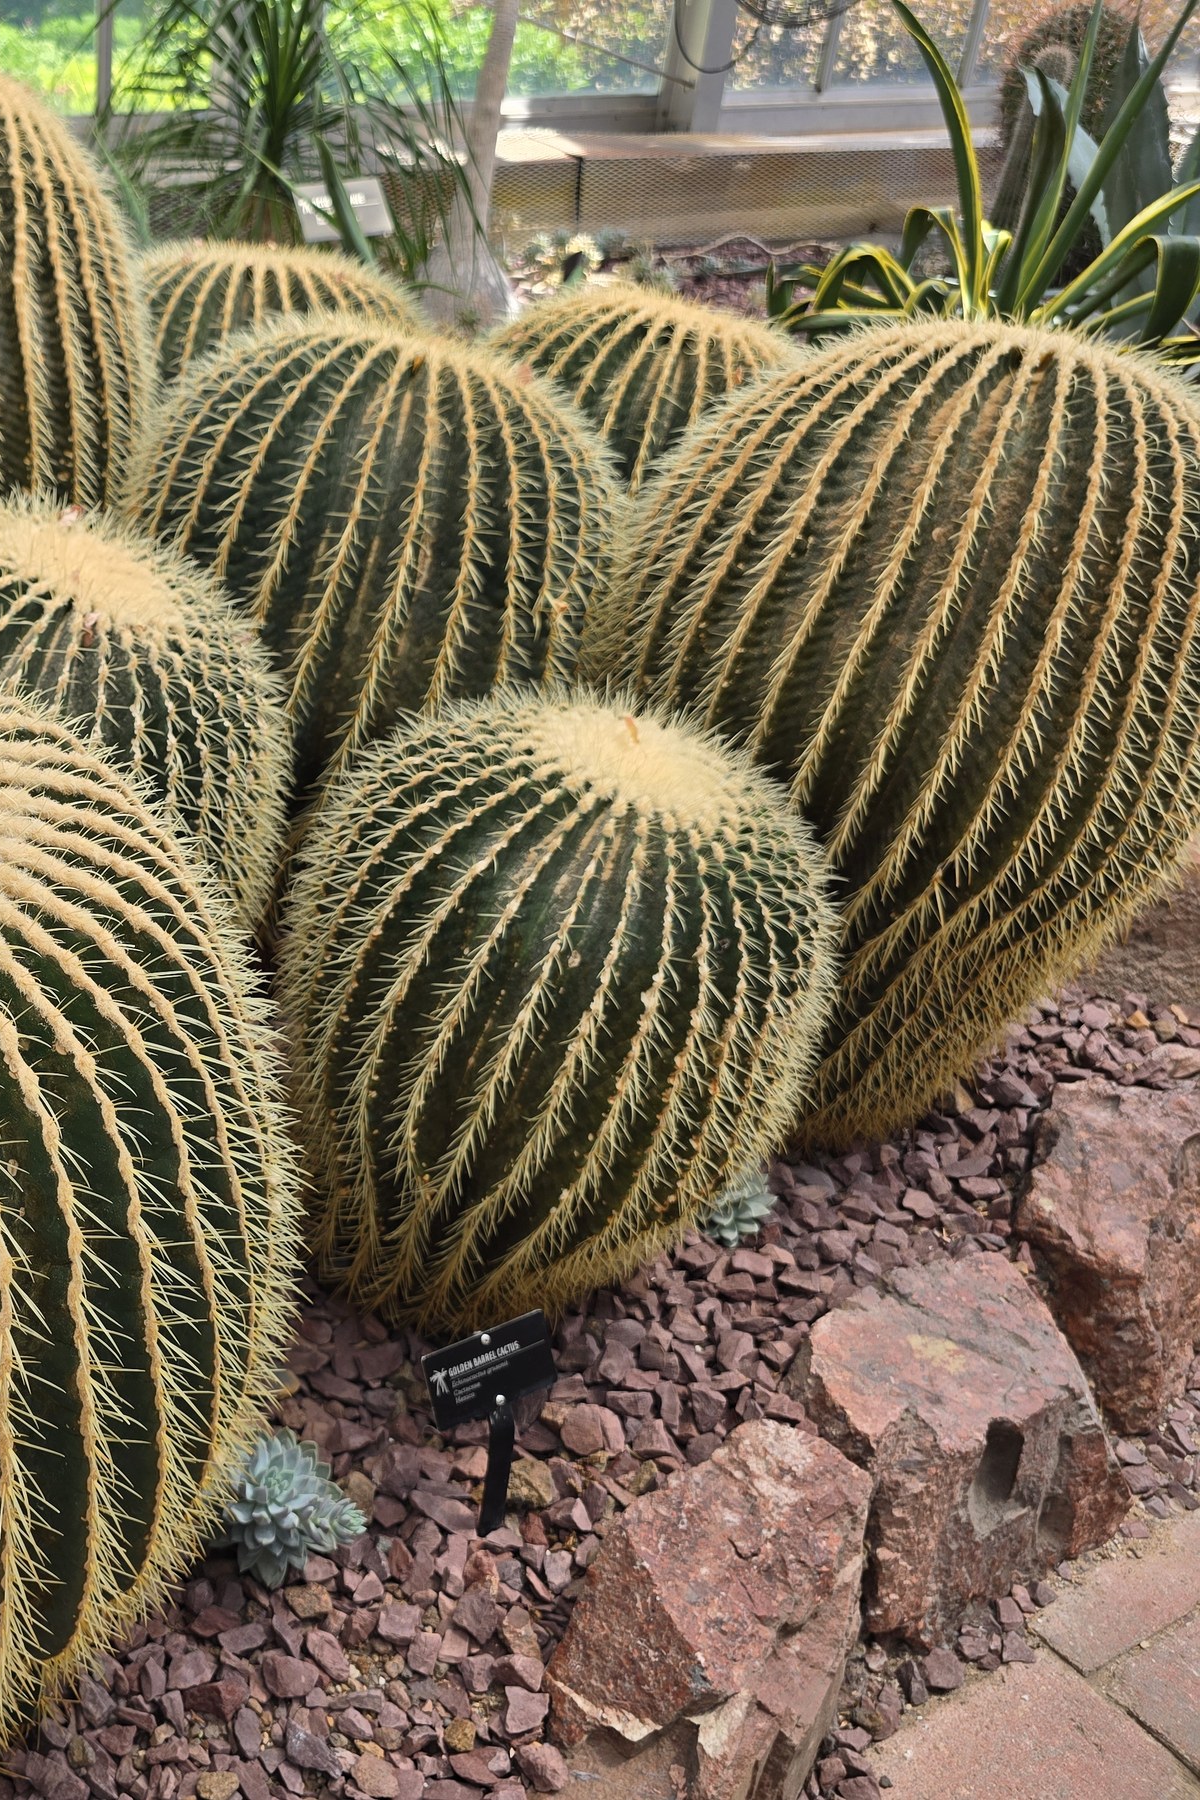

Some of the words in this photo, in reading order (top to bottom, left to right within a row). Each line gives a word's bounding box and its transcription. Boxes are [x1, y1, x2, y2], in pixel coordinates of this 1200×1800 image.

[448, 1360, 473, 1377] GOLDEN
[473, 1350, 497, 1367] BARREL
[497, 1340, 520, 1357] CACTUS
